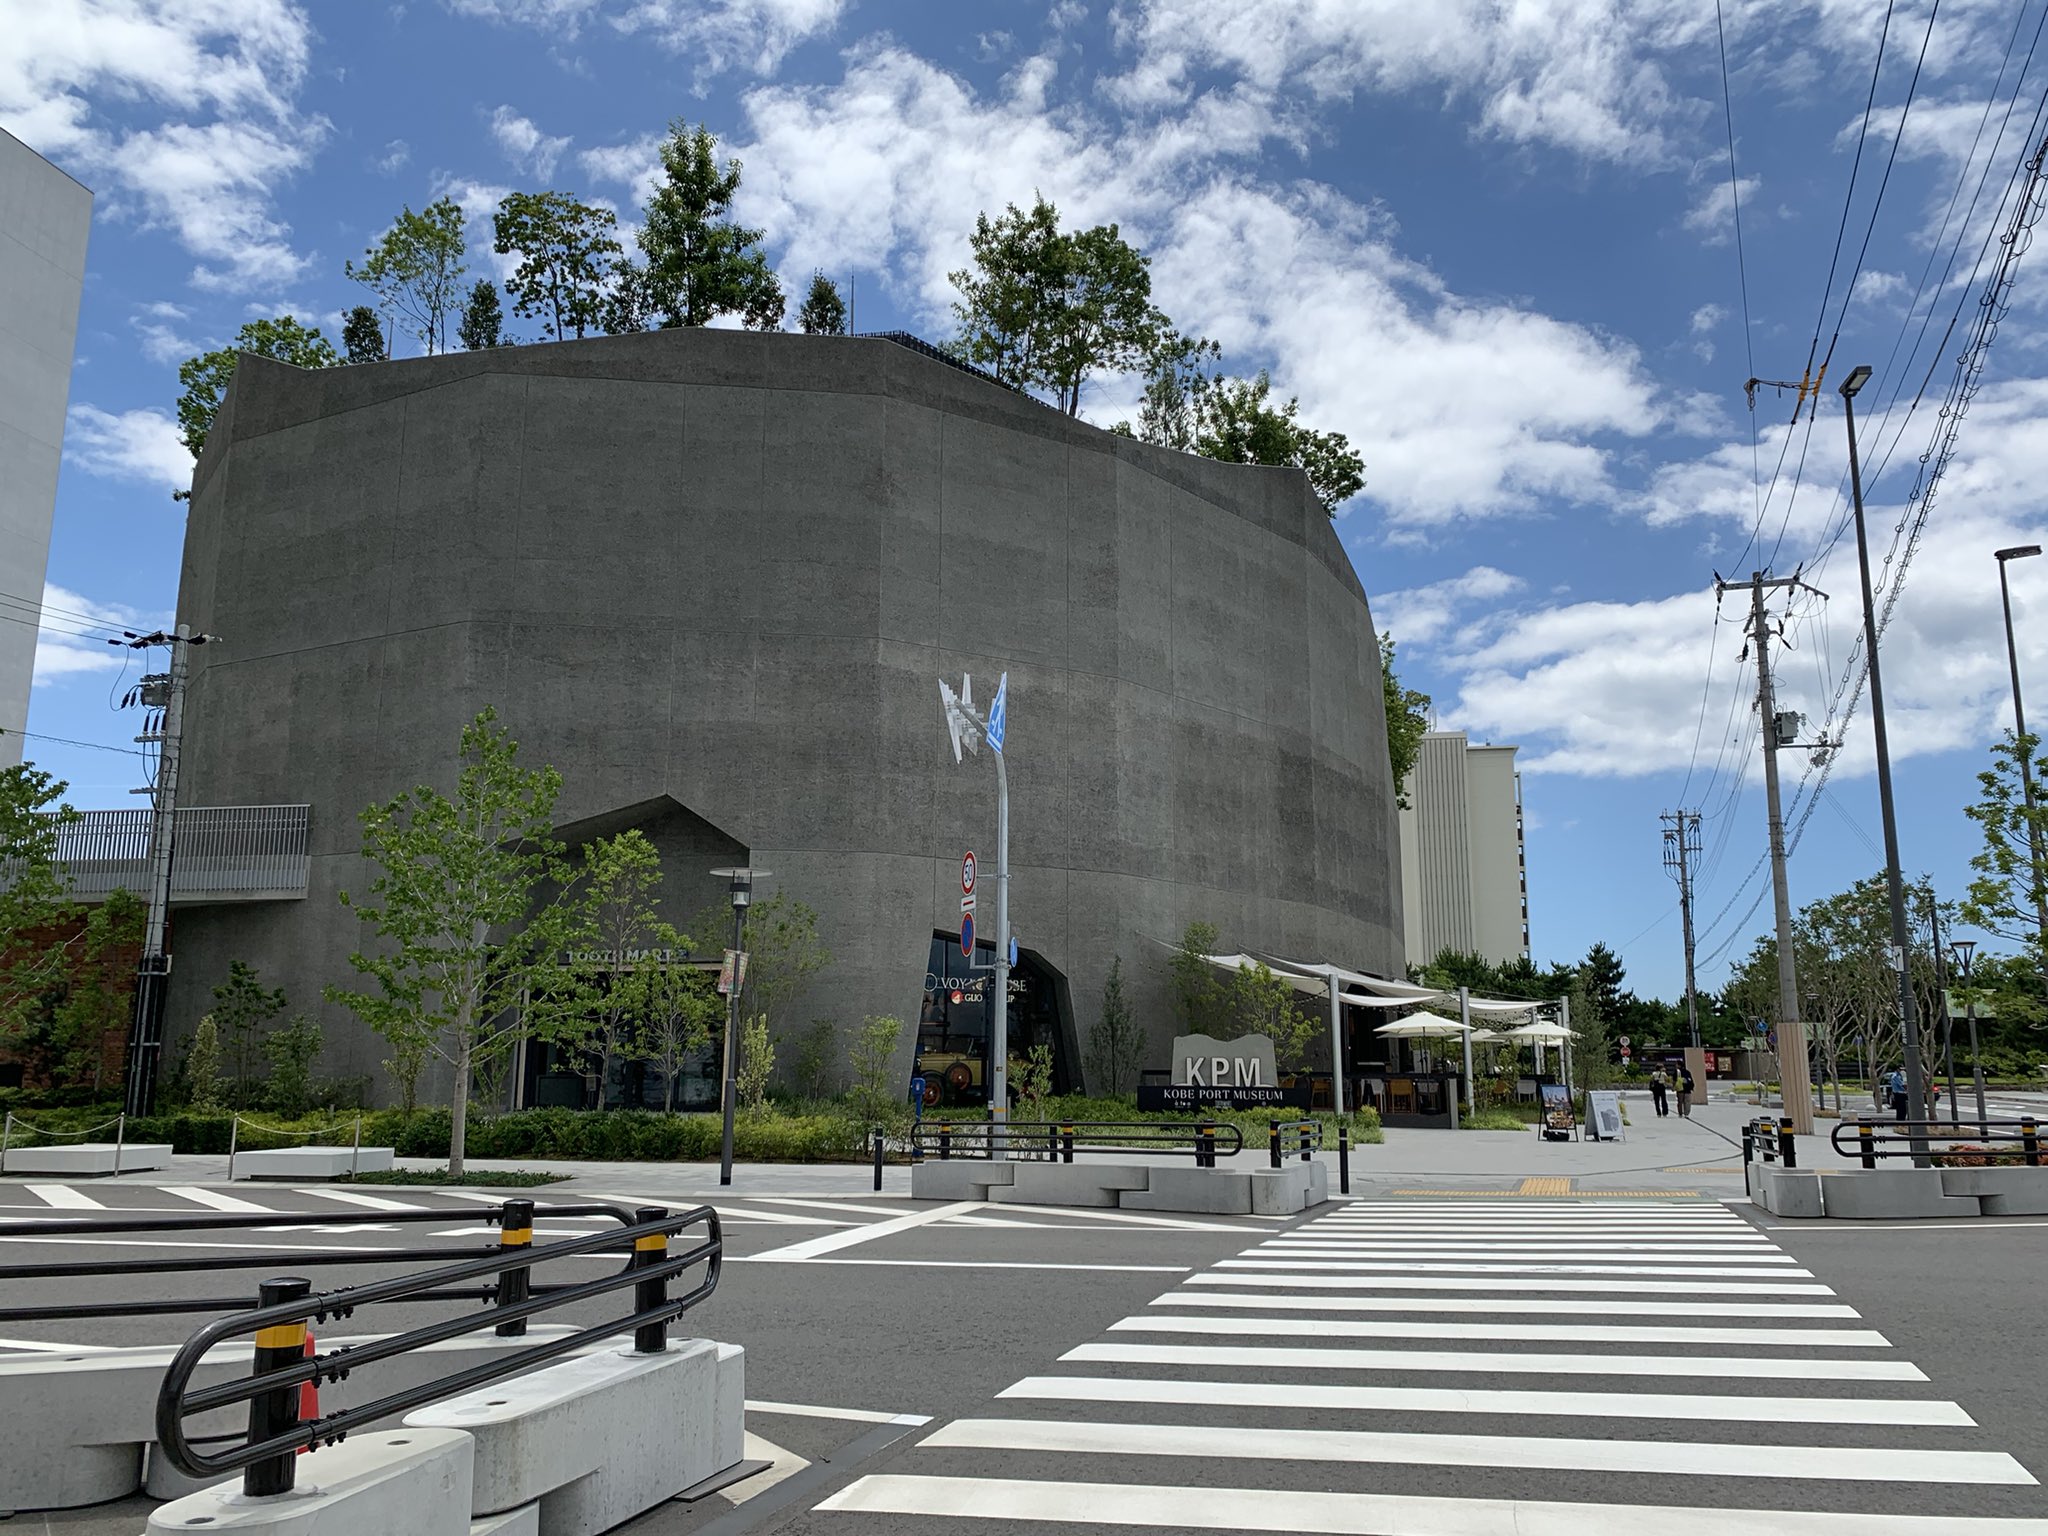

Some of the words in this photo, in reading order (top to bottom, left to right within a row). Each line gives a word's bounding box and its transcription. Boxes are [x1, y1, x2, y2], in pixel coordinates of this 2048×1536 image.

[626, 949, 671, 962] MART
[1186, 1057, 1261, 1087] KPM
[1163, 1089, 1195, 1099] KOBE
[1199, 1089, 1230, 1100] PORT
[1233, 1090, 1283, 1100] MUSEUM
